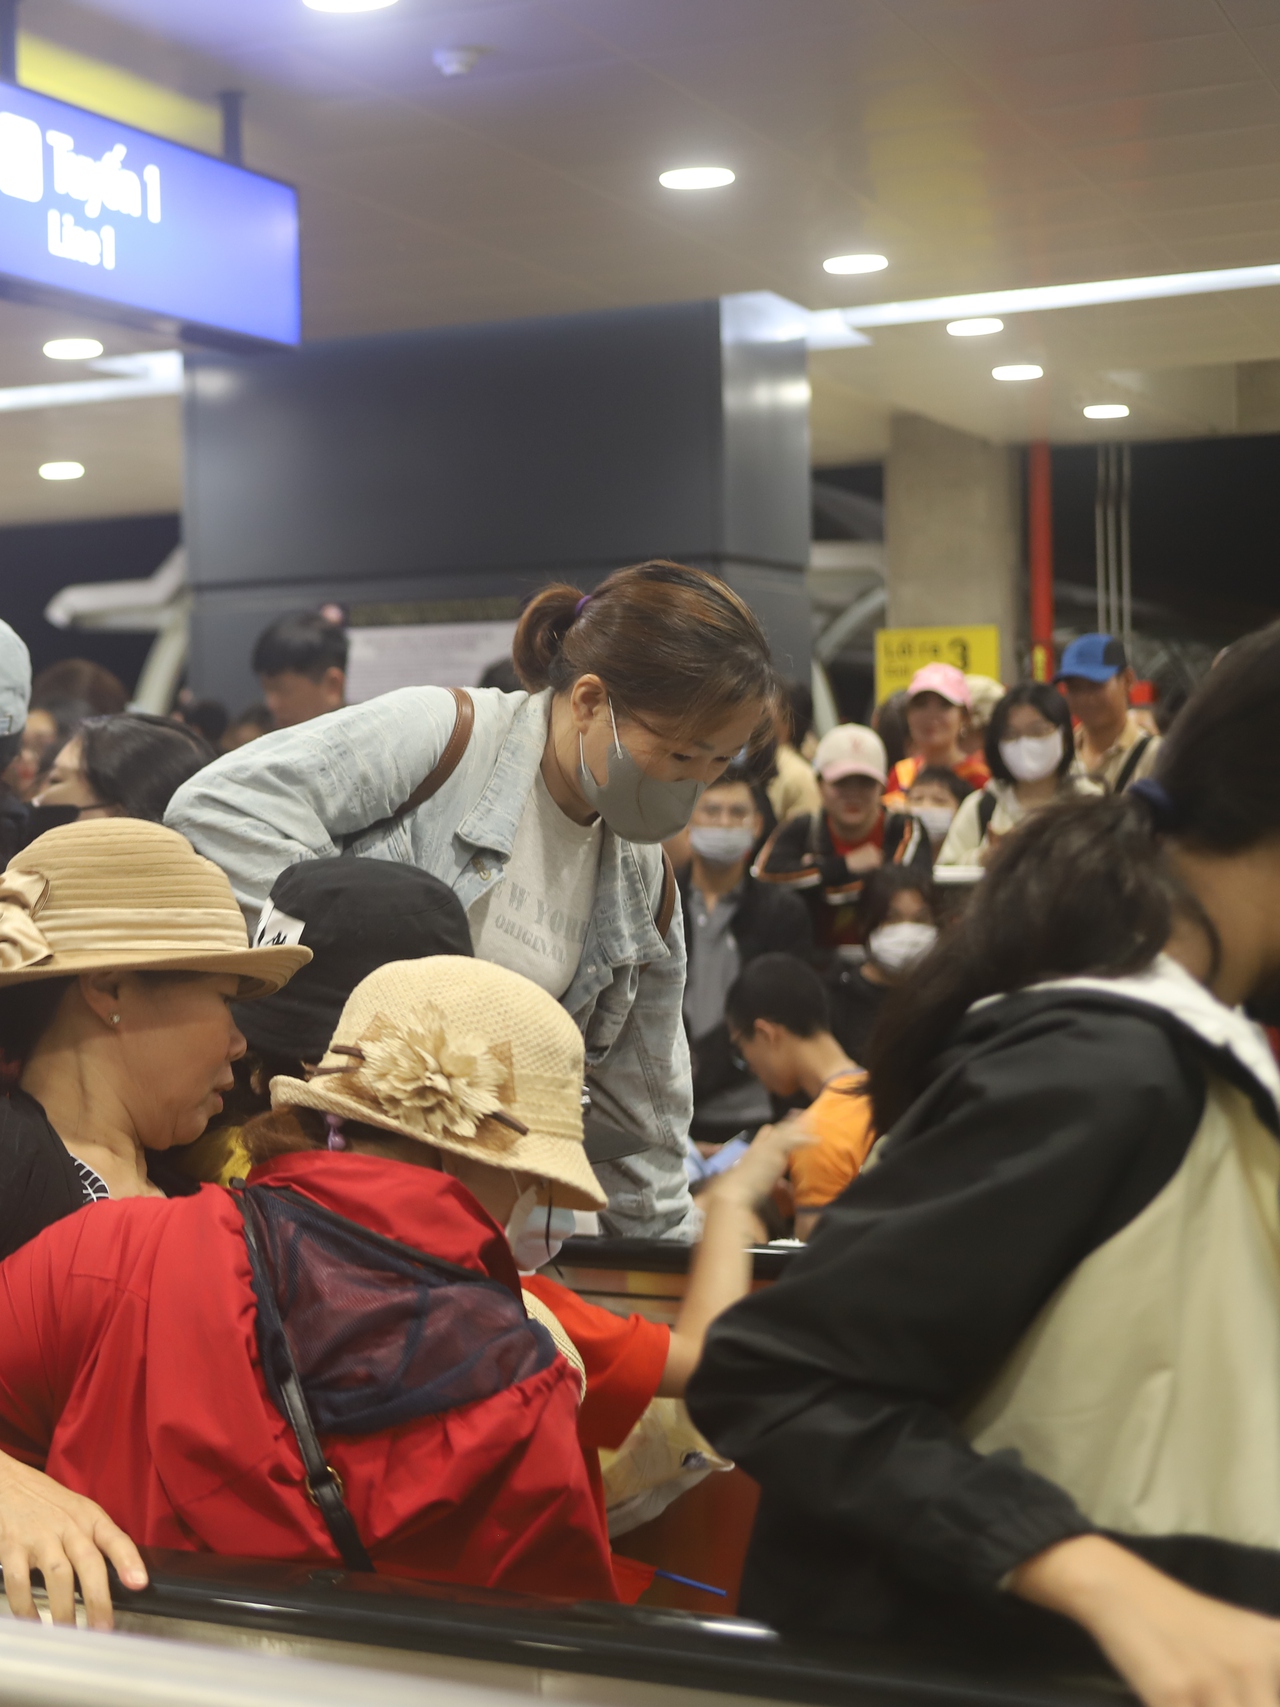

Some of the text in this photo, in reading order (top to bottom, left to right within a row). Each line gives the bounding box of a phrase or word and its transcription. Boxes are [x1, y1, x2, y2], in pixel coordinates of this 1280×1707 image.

[143, 164, 161, 224] 1
[47, 208, 116, 270] Line 1
[947, 635, 970, 671] 3
